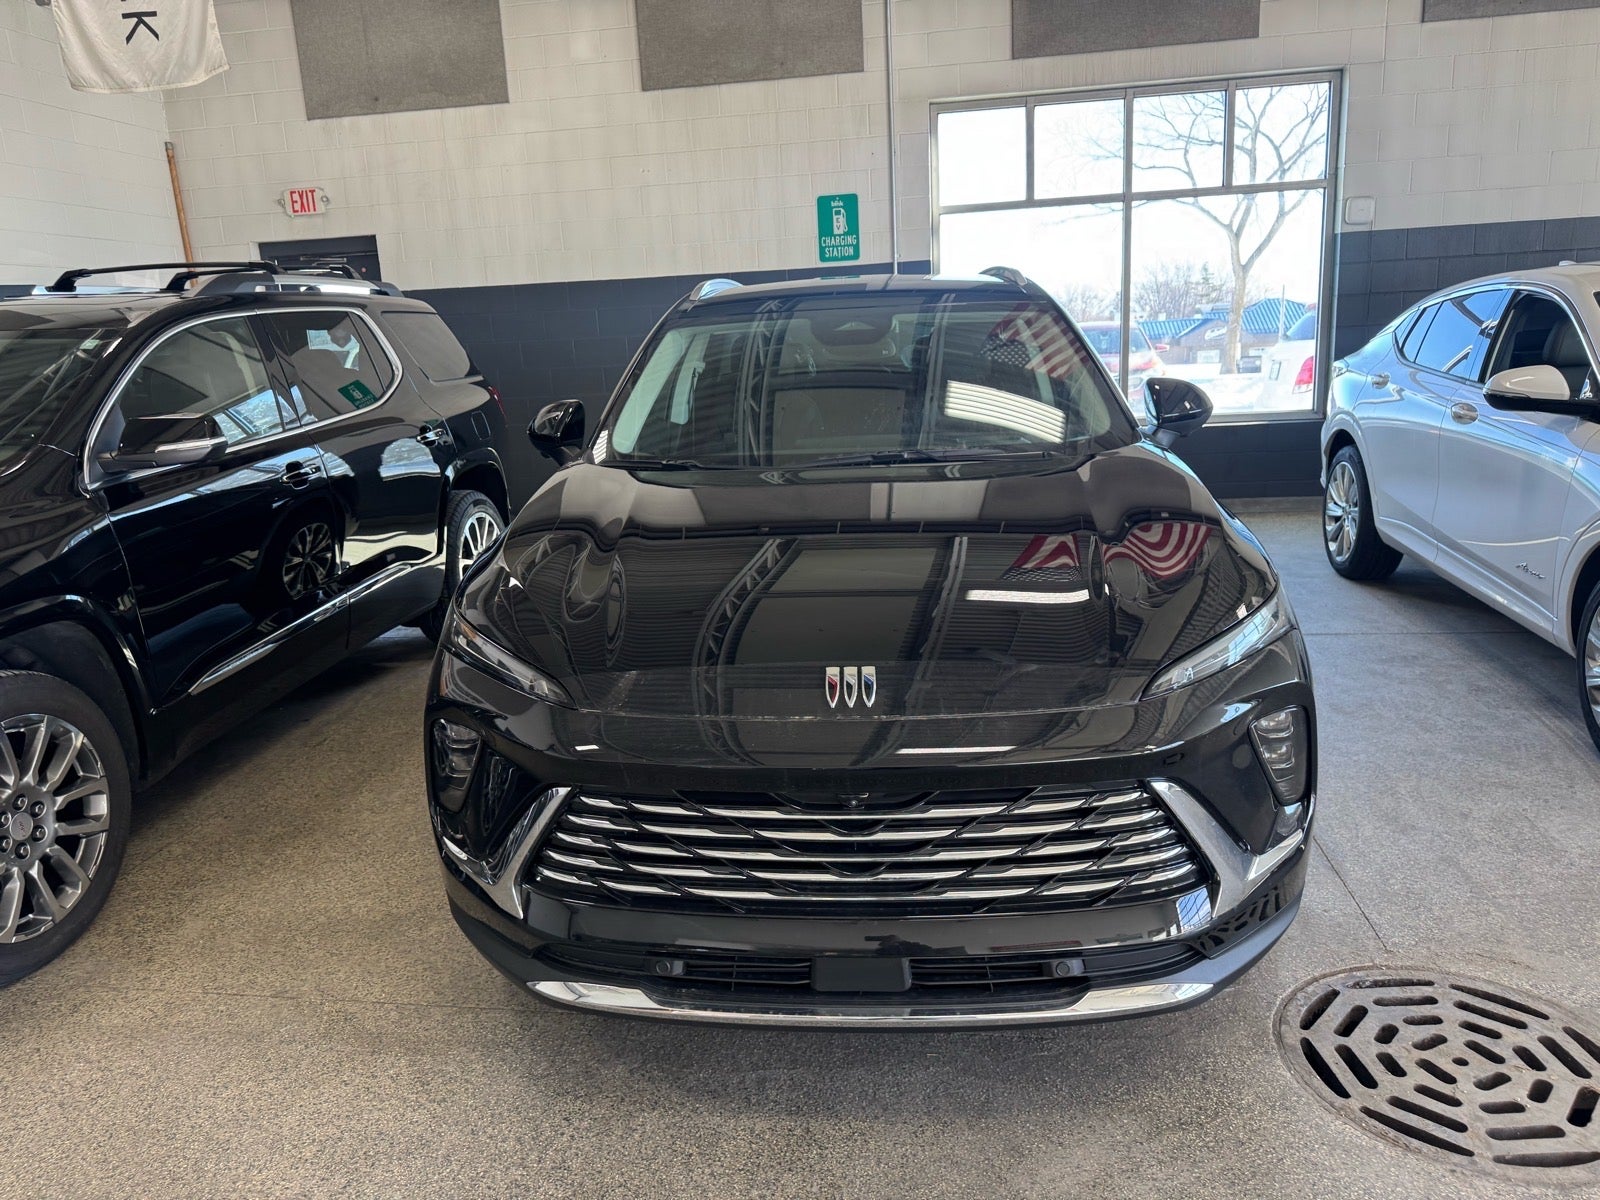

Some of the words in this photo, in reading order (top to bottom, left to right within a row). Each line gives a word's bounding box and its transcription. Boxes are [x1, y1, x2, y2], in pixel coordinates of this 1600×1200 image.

[121, 0, 160, 46] K
[289, 189, 317, 213] EXIT
[821, 235, 857, 247] CHARGING
[824, 246, 854, 258] STATION
